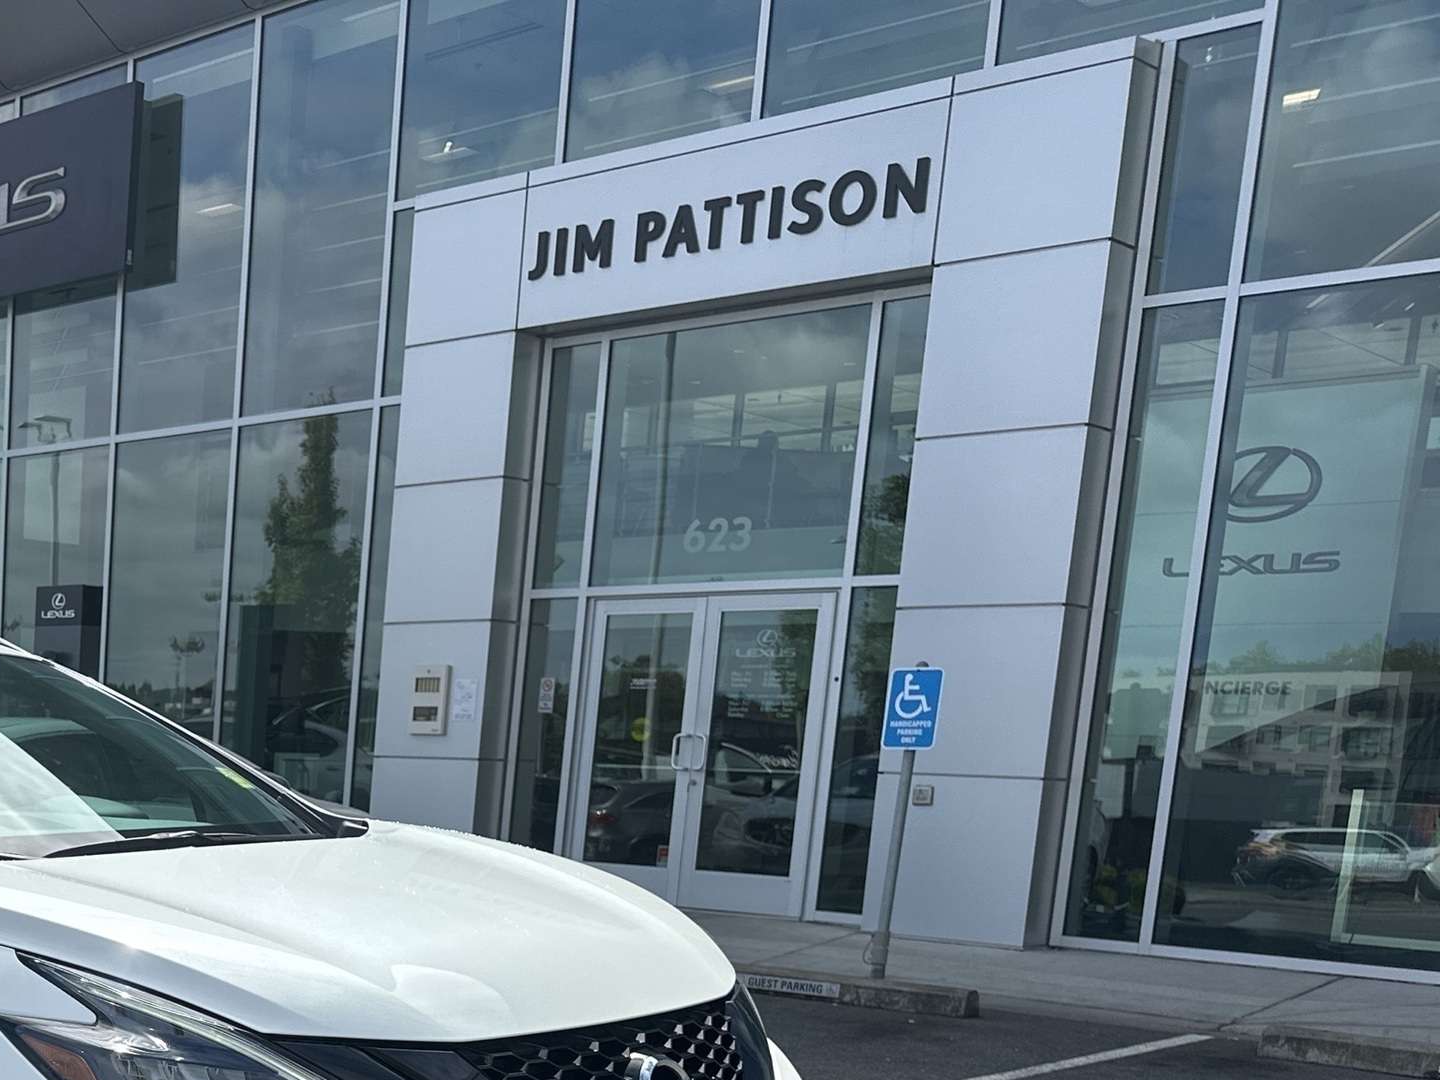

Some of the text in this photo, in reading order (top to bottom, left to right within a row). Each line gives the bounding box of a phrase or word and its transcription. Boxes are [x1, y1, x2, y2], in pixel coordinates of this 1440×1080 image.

[528, 157, 931, 281] JIM PATTISON
[683, 516, 752, 553] 623
[41, 609, 76, 619] LEXUS
[735, 647, 796, 658] LEXUS
[1204, 681, 1292, 696] NCIERGE
[889, 720, 932, 728] HANDICAPPED
[896, 728, 923, 736] PARKING
[747, 976, 824, 994] GUEST PARKING
